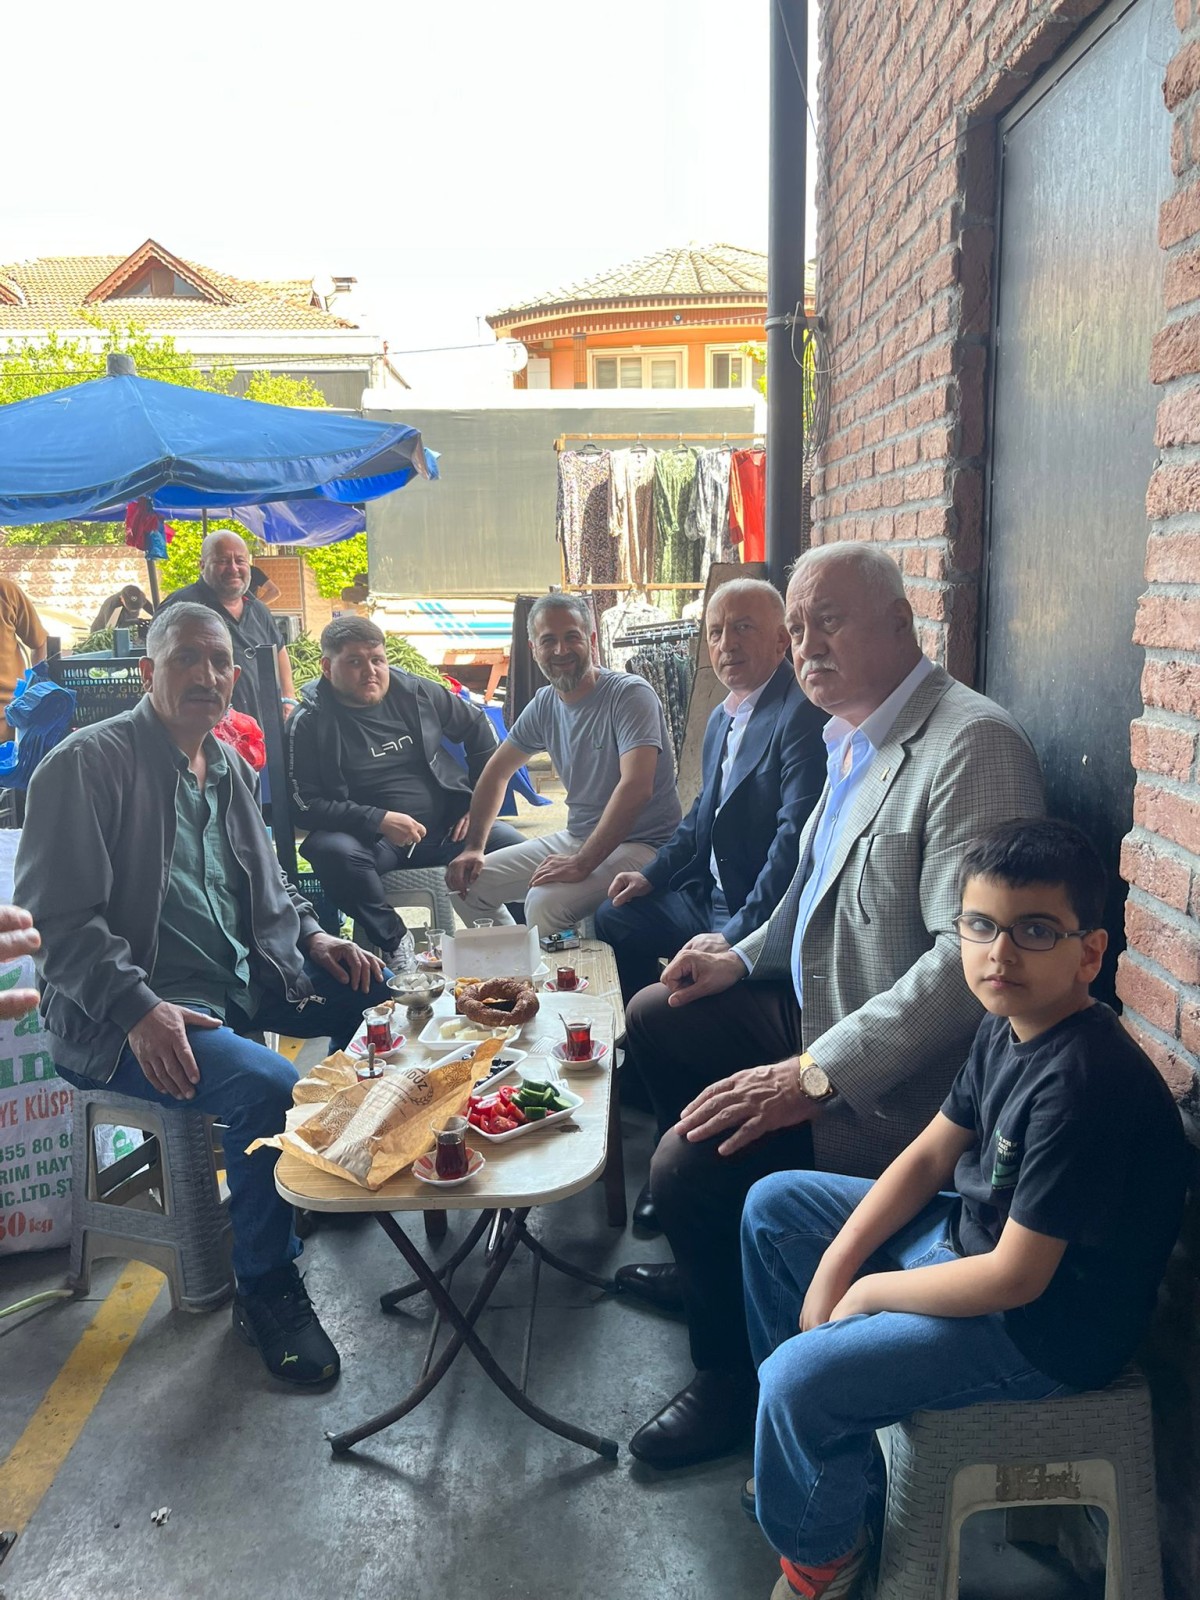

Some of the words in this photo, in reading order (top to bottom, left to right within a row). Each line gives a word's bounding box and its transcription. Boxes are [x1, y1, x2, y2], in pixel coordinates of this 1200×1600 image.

[32, 1137, 53, 1154] 80
[59, 1132, 73, 1149] 8
[29, 1216, 53, 1233] kg
